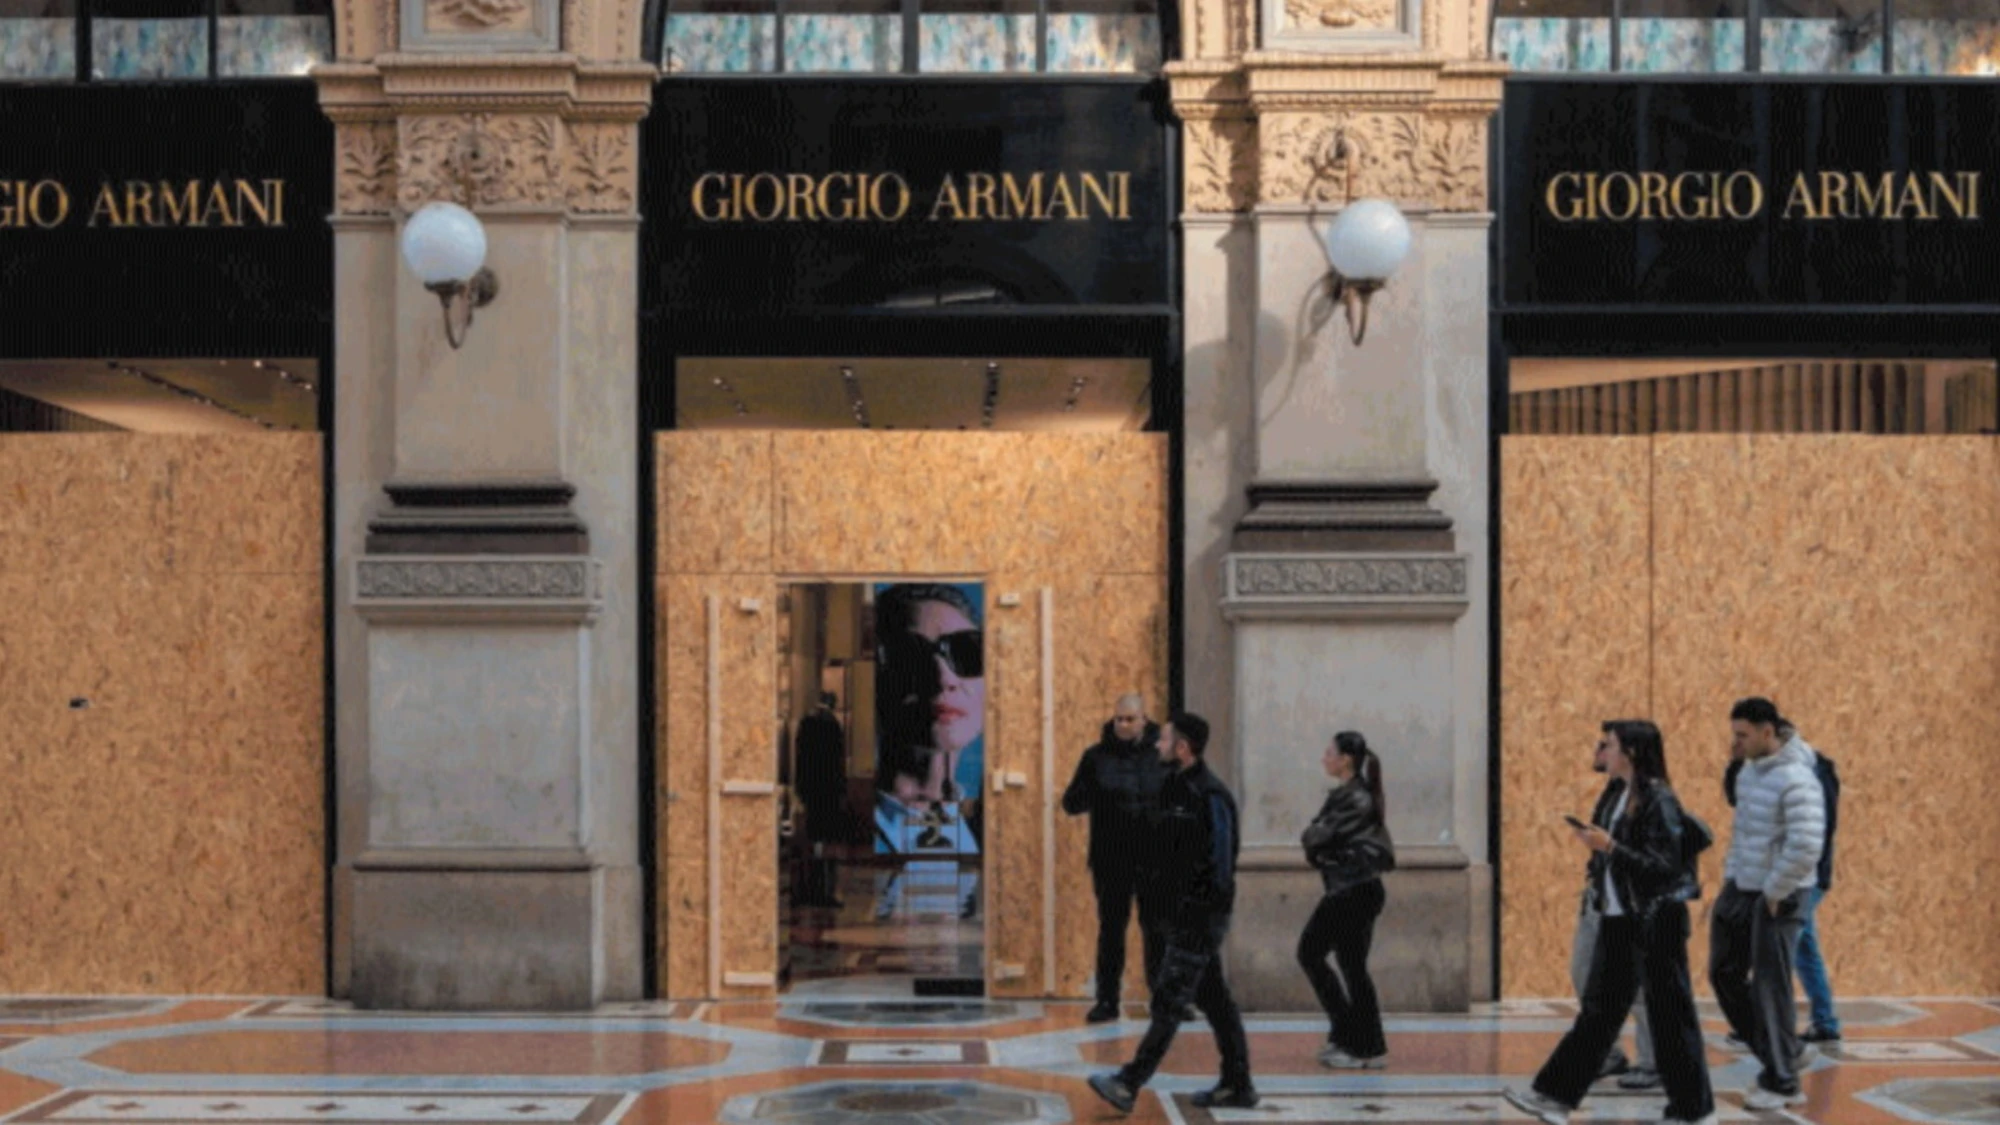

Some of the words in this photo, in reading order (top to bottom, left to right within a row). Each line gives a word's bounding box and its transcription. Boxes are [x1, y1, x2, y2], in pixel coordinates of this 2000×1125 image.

[87, 179, 285, 227] ARMANI
[691, 172, 910, 221] GIORGIO
[929, 171, 1131, 221] ARMANI
[1545, 171, 1763, 220] GIORGIO
[1782, 171, 1981, 219] ARMANI
